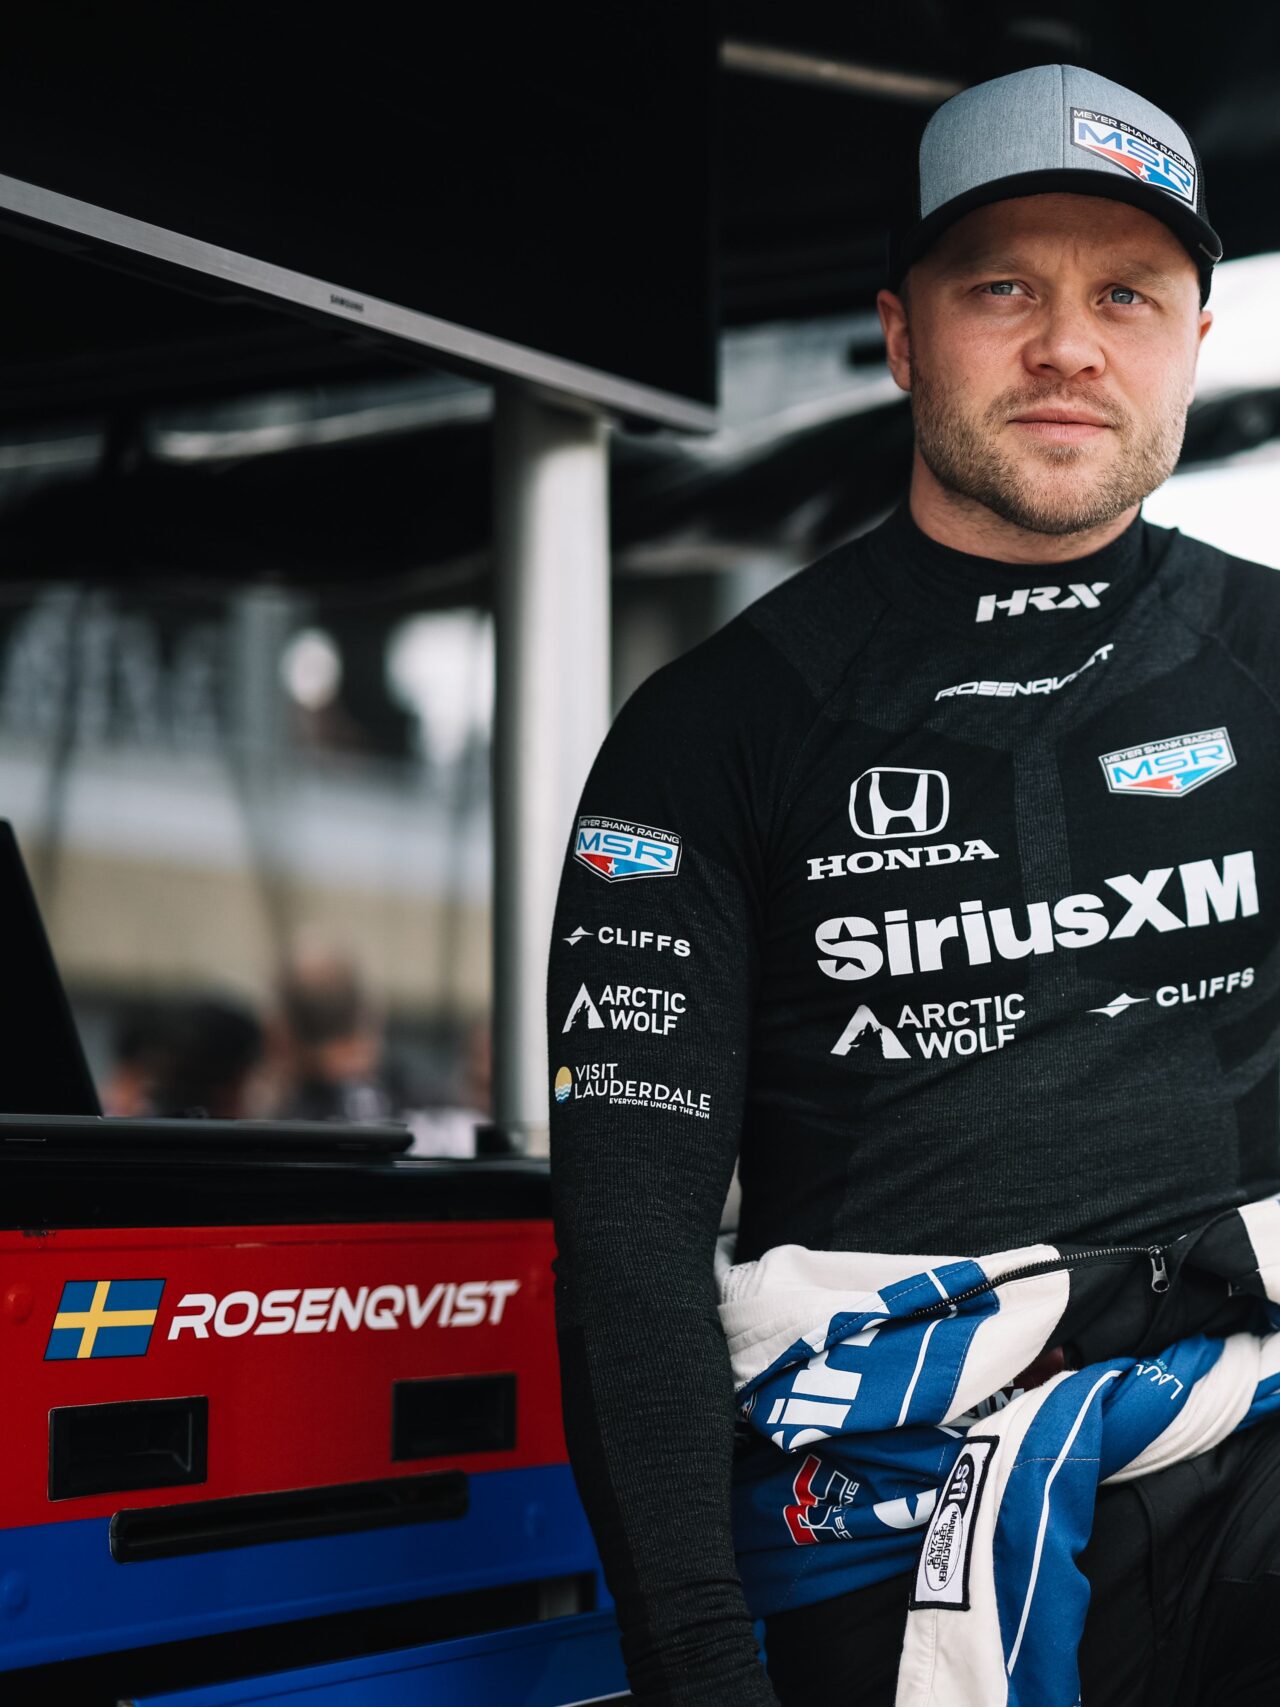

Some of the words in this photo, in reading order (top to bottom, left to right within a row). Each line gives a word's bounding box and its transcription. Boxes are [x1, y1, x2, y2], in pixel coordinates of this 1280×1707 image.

[1073, 109, 1118, 128] MEYER
[1119, 123, 1160, 150] SHANK
[1159, 144, 1195, 174] RACING
[1078, 122, 1192, 193] MSR
[975, 581, 1111, 623] HRX
[1103, 748, 1143, 765] MEYER
[1143, 739, 1182, 755] SHANK
[1182, 730, 1225, 746] RACING
[1112, 744, 1225, 784] MSR
[577, 831, 674, 867] MSR
[601, 820, 635, 834] SHANK
[636, 827, 681, 844] RACING
[806, 838, 1000, 881] HONDA
[814, 850, 1260, 982] SiriusXM
[597, 926, 692, 958] CLIFFS
[598, 984, 688, 1014] ARCTIC
[1154, 967, 1256, 1008] CLIFFS
[609, 1009, 679, 1036] WOLF
[896, 993, 1027, 1029] ARCTIC
[914, 1023, 1018, 1060] WOLF
[574, 1063, 619, 1081] VISIT
[573, 1080, 712, 1112] LAUDERDALE
[609, 1097, 649, 1107] EVERYONE
[650, 1100, 677, 1111] UNDER
[679, 1105, 694, 1116] THE
[695, 1109, 710, 1120] SUN
[167, 1279, 521, 1341] ROSENQVIST
[932, 1522, 950, 1570] CERTIFIED
[938, 1511, 958, 1583] MANUFACTURER
